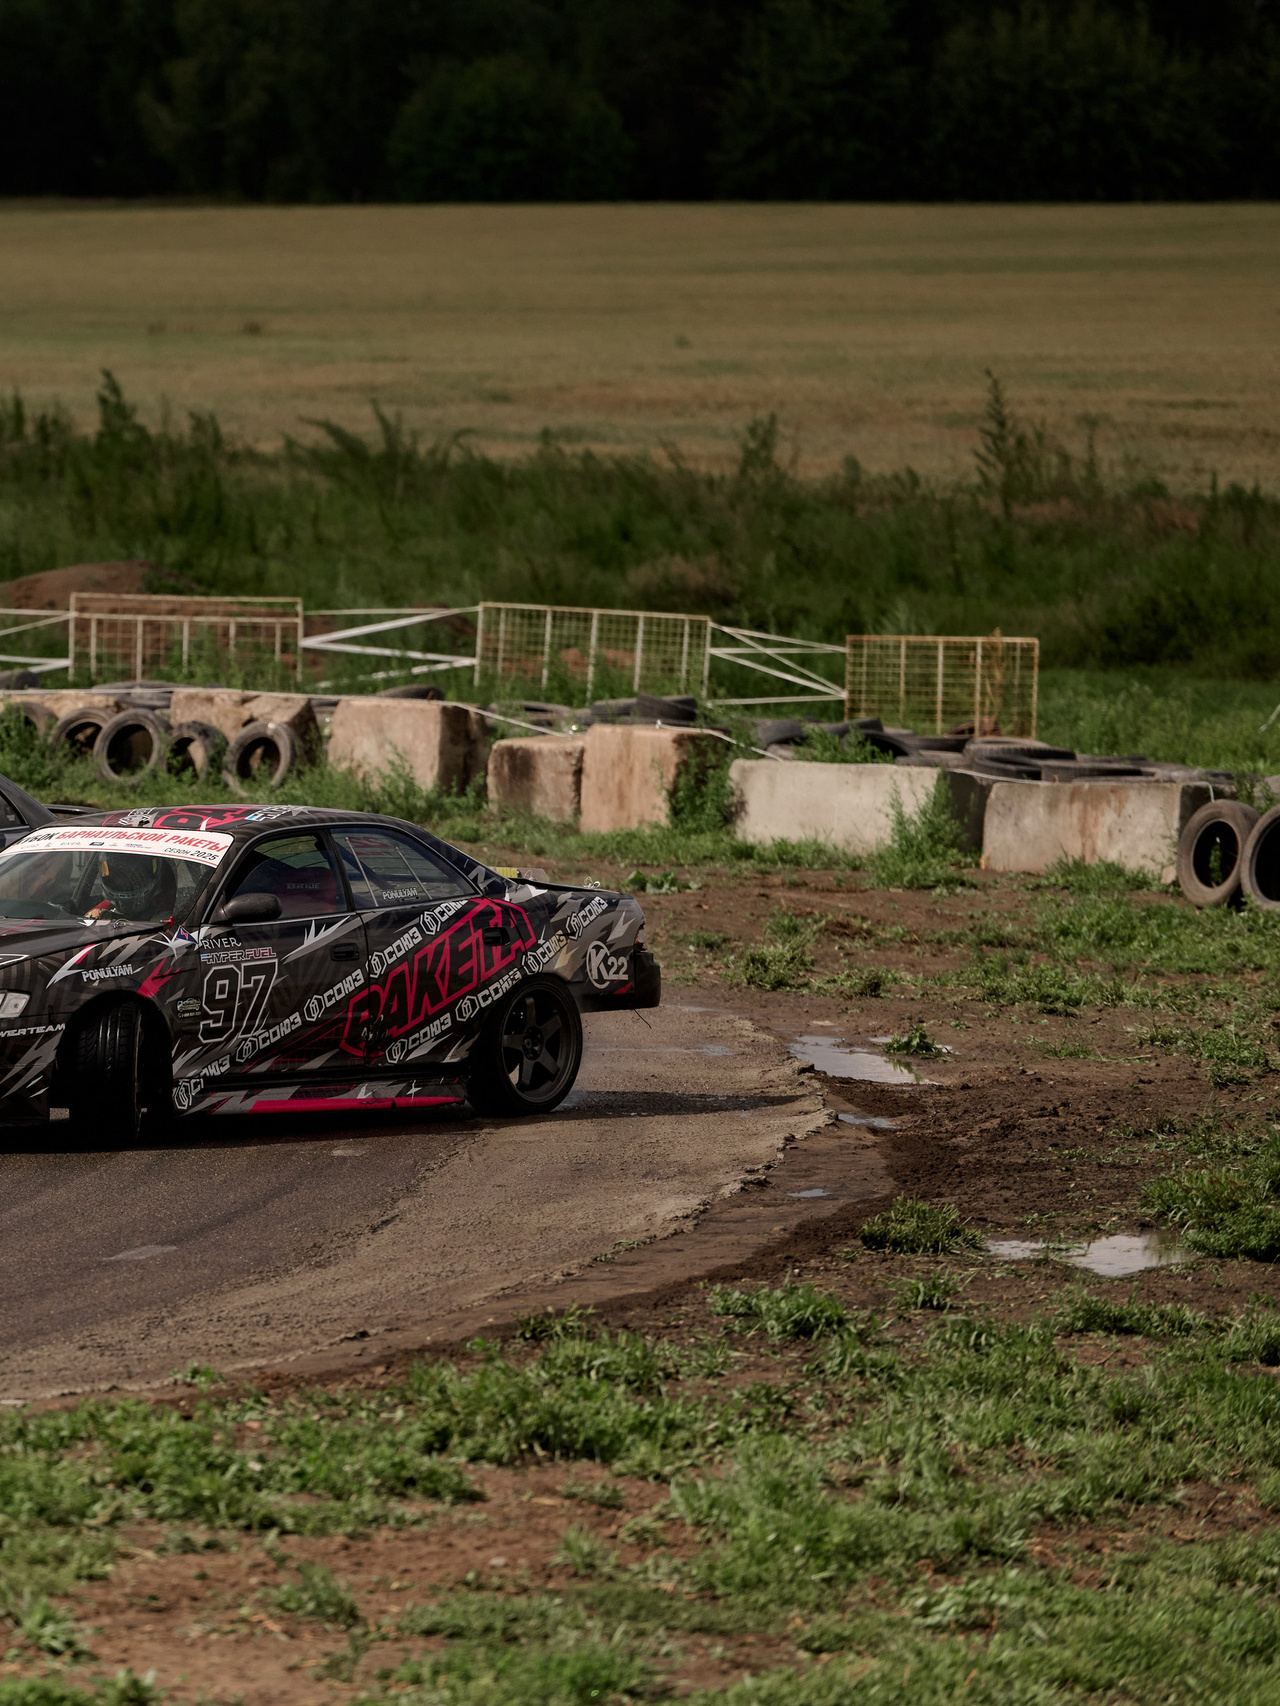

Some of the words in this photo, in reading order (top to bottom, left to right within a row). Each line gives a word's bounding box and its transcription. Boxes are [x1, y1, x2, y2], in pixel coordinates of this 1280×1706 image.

[55, 830, 168, 843] БАРНАУЛЬСКОЙ
[169, 834, 228, 851] РАКЕТЫ
[164, 847, 190, 856] СЕЗОН
[190, 850, 219, 861] 2025
[578, 896, 609, 928] СОЮЗ
[202, 937, 242, 949] RIVER
[384, 926, 422, 965] СОЮЗ
[536, 930, 568, 964] СОЮЗ
[82, 963, 133, 982] PONULYAM
[323, 968, 365, 1008] СОЮЗ
[479, 967, 523, 1008] СОЮЗ
[198, 958, 278, 1043] 97
[259, 1011, 302, 1050] СОЮЗ
[408, 1012, 451, 1050] СОЮЗ
